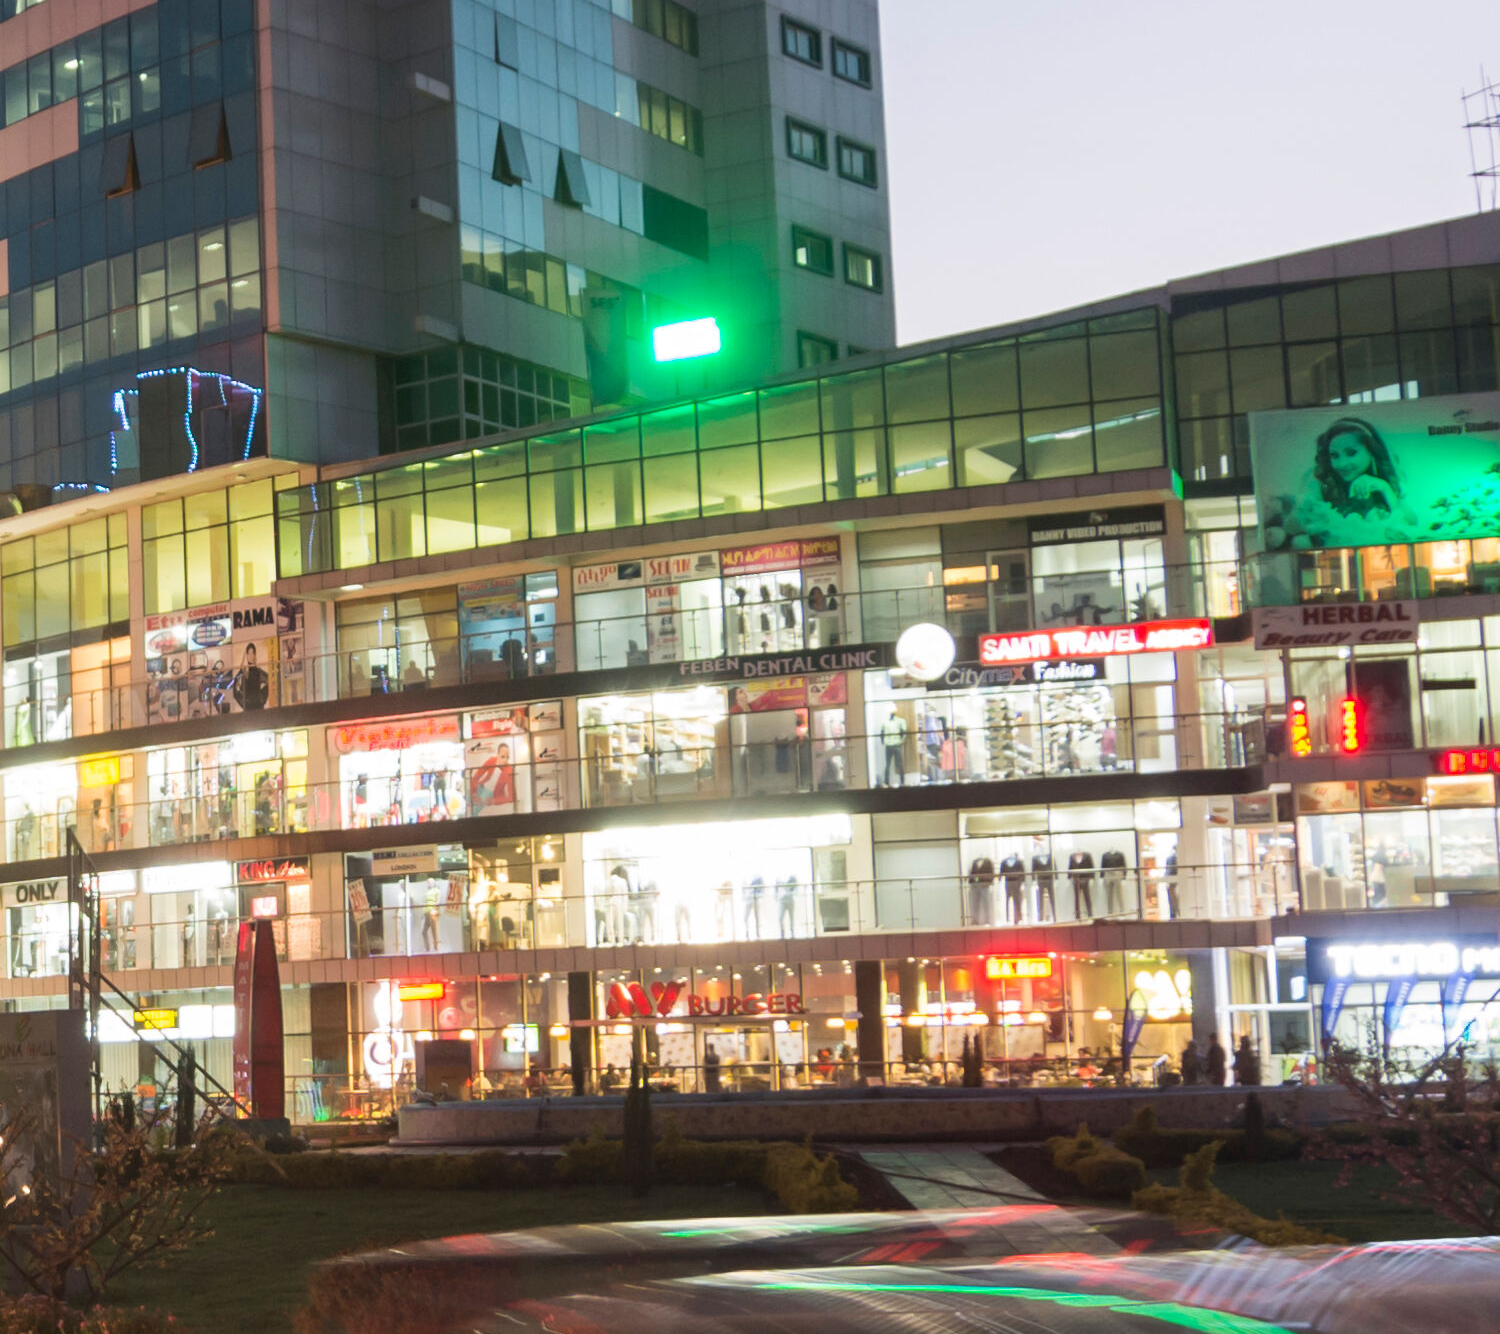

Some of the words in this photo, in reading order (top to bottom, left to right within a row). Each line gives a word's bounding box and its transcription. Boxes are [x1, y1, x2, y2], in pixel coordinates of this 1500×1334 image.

[1067, 526, 1096, 539] VIDEO
[233, 606, 275, 630] RAMA
[1302, 603, 1411, 625] HERBAL
[1053, 629, 1144, 656] TRAVEL
[1261, 630, 1351, 647] Beauty
[680, 657, 739, 676] FEBEN
[743, 656, 817, 678] DENTAL
[819, 650, 877, 669] CLINIC
[239, 862, 275, 880] KING
[16, 881, 59, 904] ONLY
[687, 993, 807, 1016] BURGER
